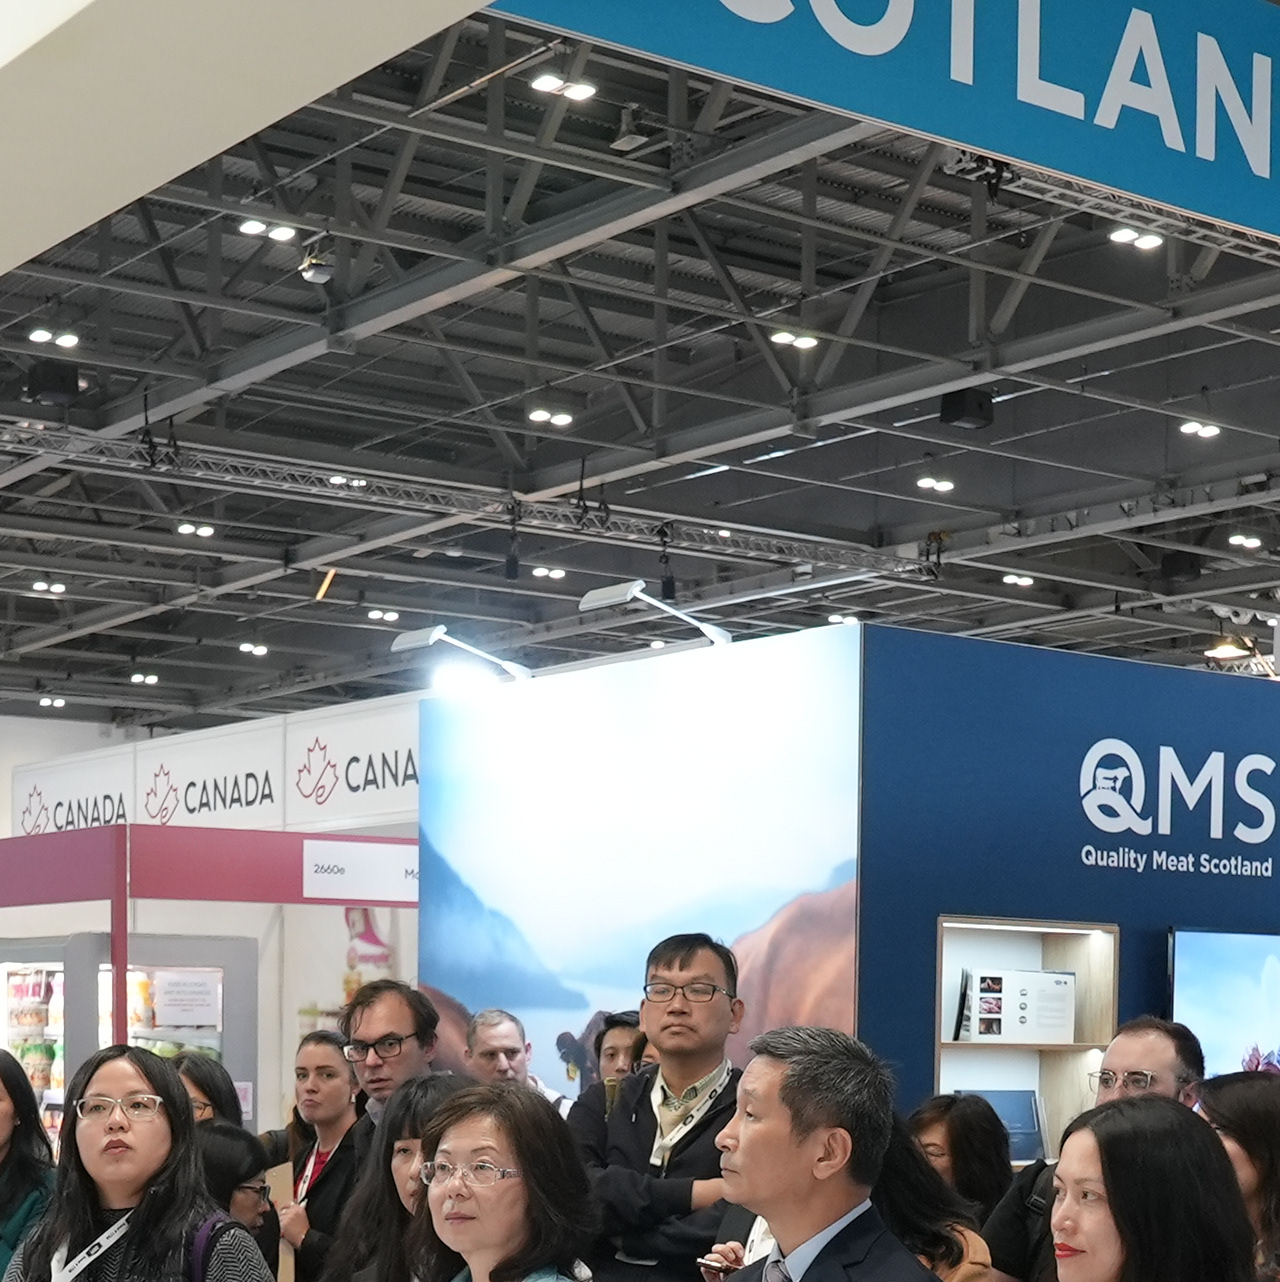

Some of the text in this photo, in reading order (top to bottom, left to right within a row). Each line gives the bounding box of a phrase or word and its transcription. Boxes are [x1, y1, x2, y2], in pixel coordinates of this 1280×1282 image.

[184, 770, 274, 814] CANADA
[345, 749, 419, 793] CANA
[1079, 738, 1277, 844] QMS
[54, 792, 127, 832] CANADA
[314, 864, 346, 876] 2660e
[1081, 845, 1273, 878] Quality Meat Scotland
